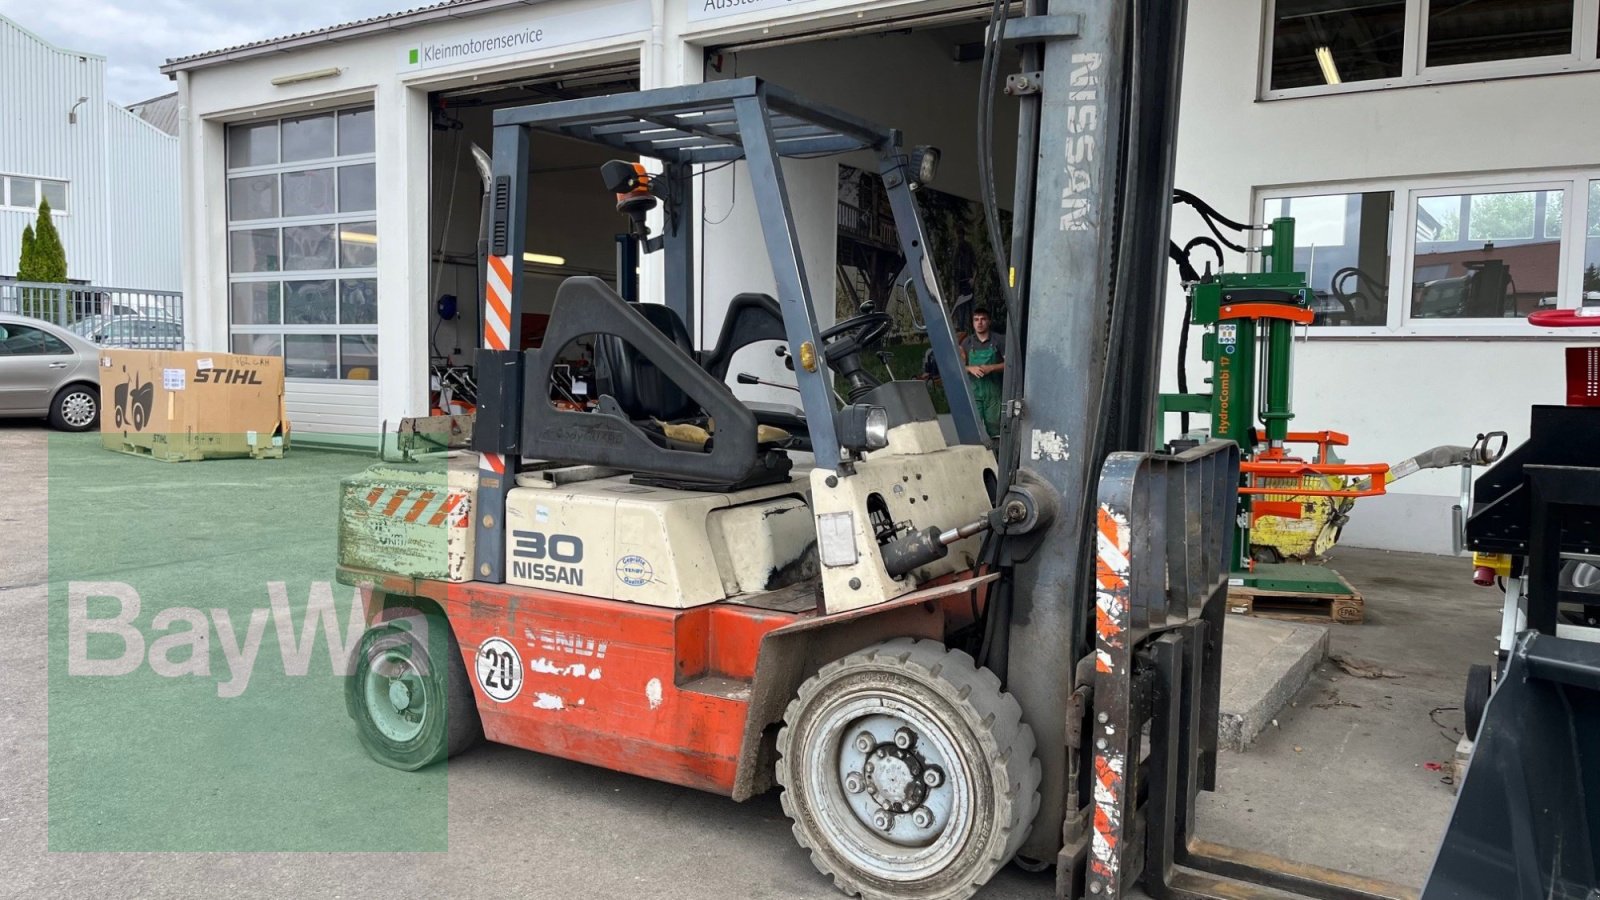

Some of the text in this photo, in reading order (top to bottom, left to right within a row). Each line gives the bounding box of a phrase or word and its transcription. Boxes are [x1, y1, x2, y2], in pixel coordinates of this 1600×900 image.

[424, 28, 543, 62] Kleinmotorenservice
[1060, 53, 1102, 231] NISSAN
[193, 368, 262, 385] STIHL
[1218, 356, 1231, 434] HydroCombi 17
[512, 529, 584, 564] 30
[513, 560, 584, 587] NISSAN
[485, 647, 514, 691] 20
